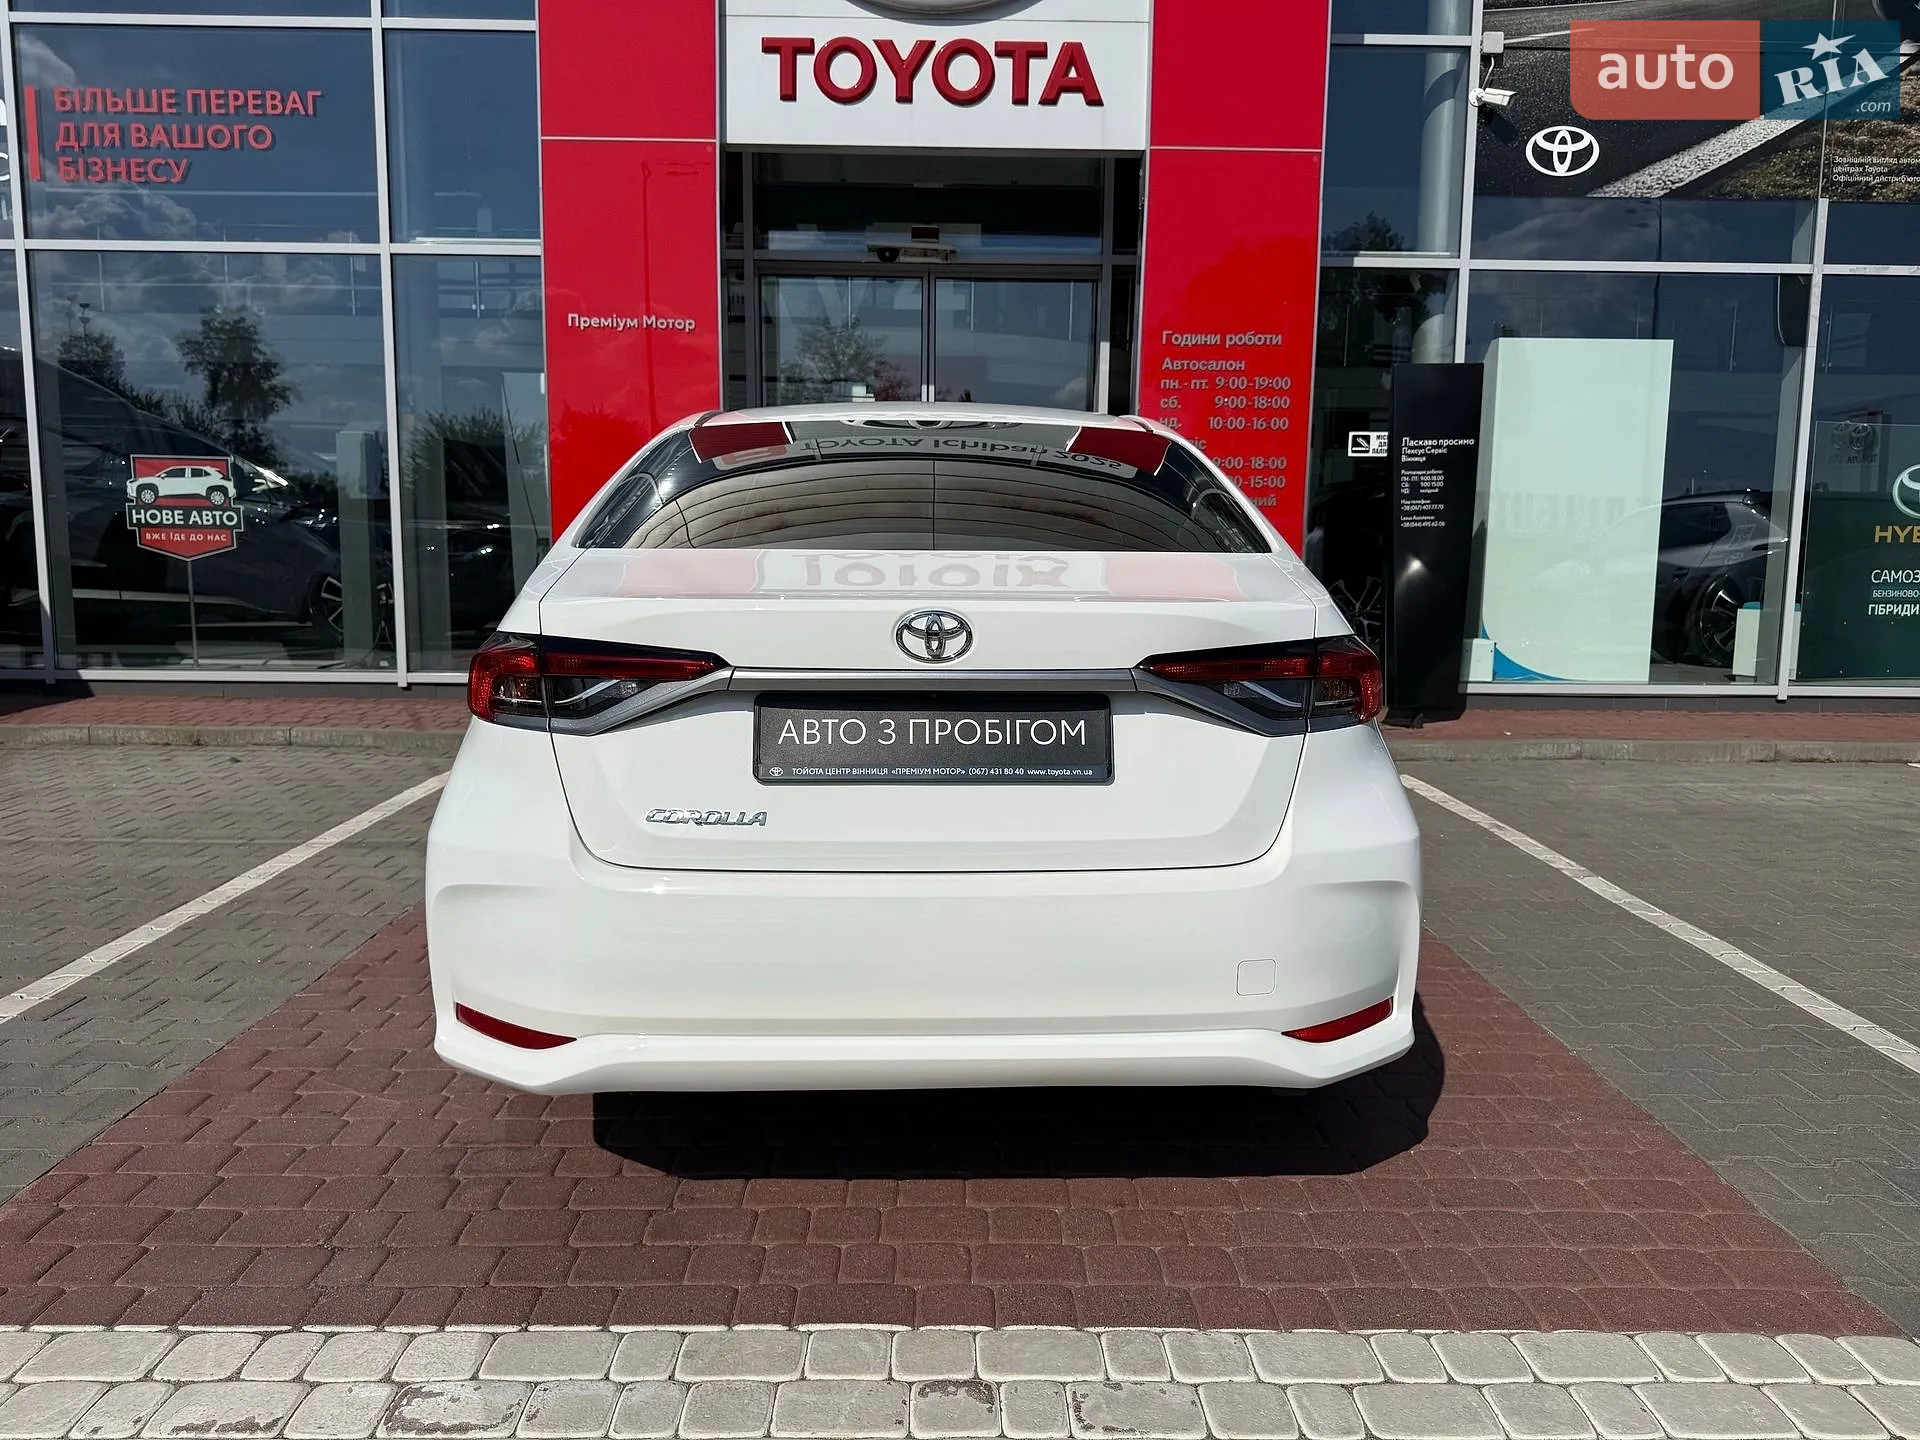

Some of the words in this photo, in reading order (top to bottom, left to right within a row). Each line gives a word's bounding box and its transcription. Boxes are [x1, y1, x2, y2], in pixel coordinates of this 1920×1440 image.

[761, 36, 1104, 106] TOYOTA
[54, 87, 178, 114] БІЛЬШЕ
[186, 88, 322, 116] ПЕРЕВАГ
[55, 121, 121, 152] ДЛЯ
[130, 123, 273, 150] ВАШОГО
[57, 156, 189, 184] БІЗНЕСУ
[1865, 165, 1889, 174] Toyota
[567, 313, 638, 331] Преміум
[642, 315, 696, 332] Мотор
[1162, 331, 1221, 347] Години
[1226, 331, 1282, 348] роботи
[1161, 357, 1245, 371] Автосалон
[1215, 376, 1292, 390] 9:00-19:00
[1160, 396, 1182, 409] сб.
[1214, 395, 1290, 409] 9:00-18:00
[1208, 416, 1289, 430] 10:00-16:00
[1401, 437, 1437, 447] Ласкаво
[132, 509, 184, 524] НОВЕ
[188, 510, 238, 525] АВТО
[170, 532, 186, 541] ЇДЕ
[1868, 604, 1920, 617] ГІБРИДИ
[777, 718, 867, 746] АВТО
[877, 718, 896, 746] З
[909, 718, 1086, 746] ПРОБІГОМ
[792, 766, 824, 776] ТОЙОТА
[825, 767, 851, 777] ЦЕНТР
[852, 767, 888, 777] ВІННИЦЯ
[891, 767, 931, 776] «ПРЕМІУМ
[933, 767, 965, 776] МОТОР»
[968, 767, 988, 776] (067)
[990, 767, 1002, 776] 431
[1003, 767, 1013, 776] 80
[1014, 767, 1024, 776] 40
[1027, 767, 1093, 777] www.toyota.vn.ua
[645, 808, 768, 827] COROLLA
